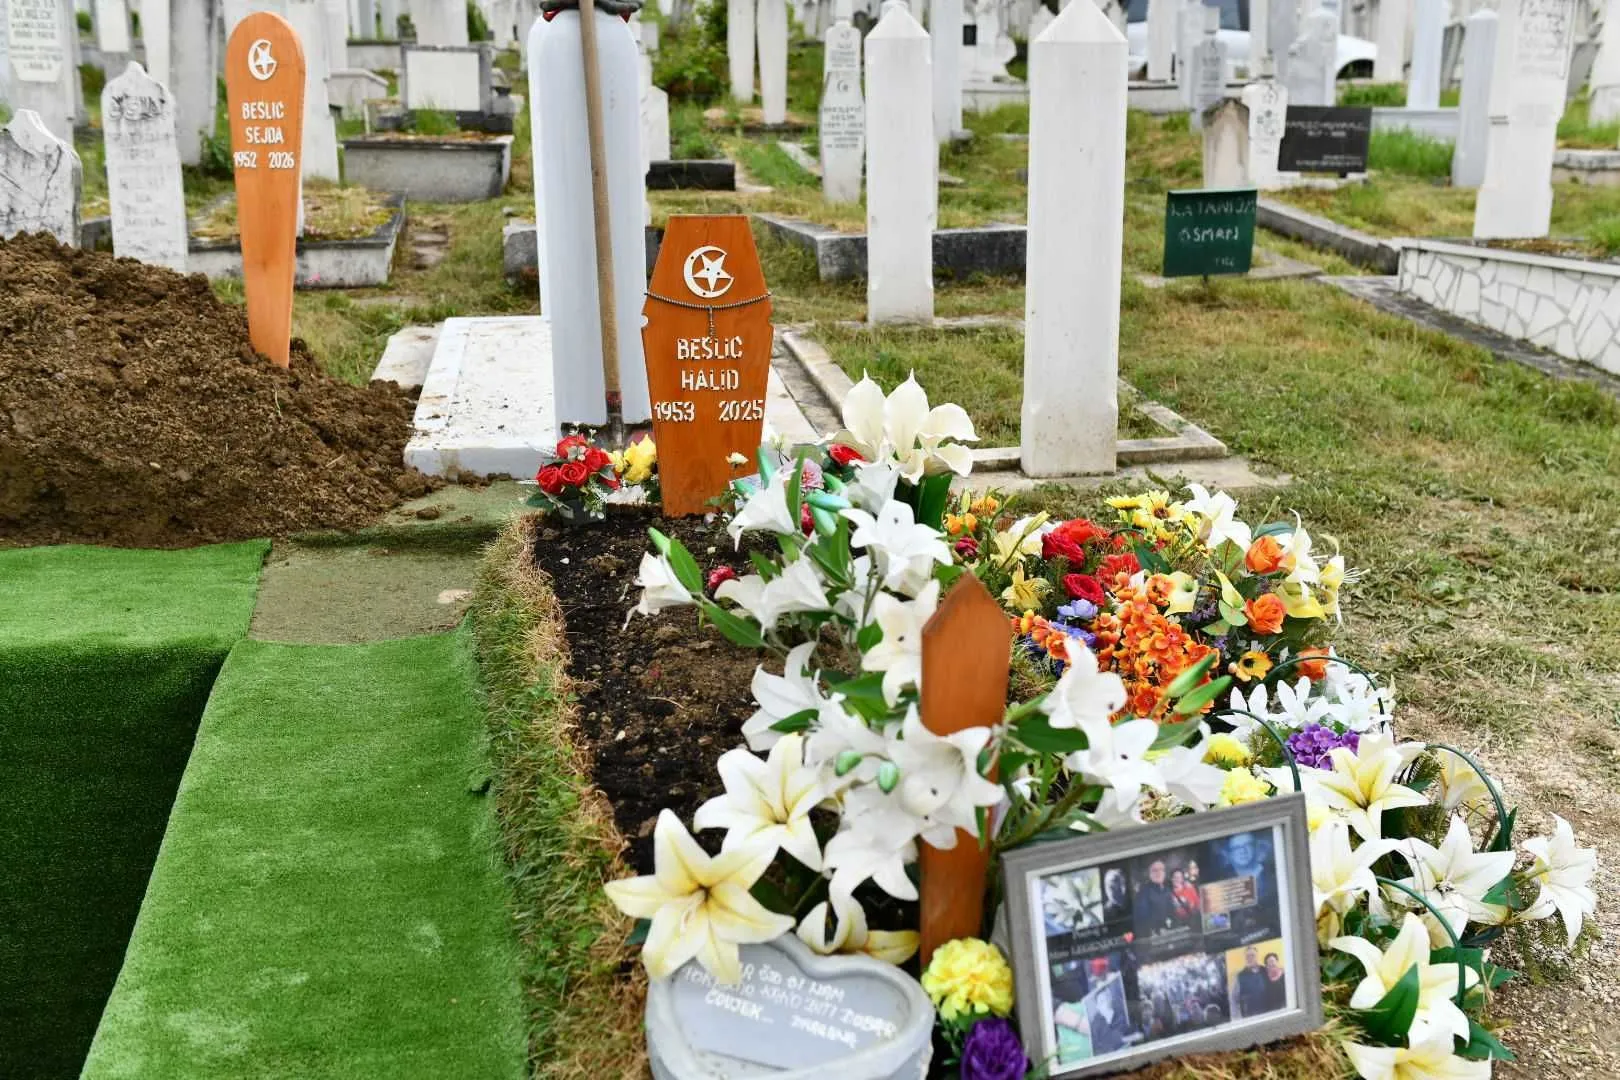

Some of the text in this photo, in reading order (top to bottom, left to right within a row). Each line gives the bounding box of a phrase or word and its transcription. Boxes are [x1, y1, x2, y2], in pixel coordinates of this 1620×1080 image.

[245, 126, 284, 144] SEJDA
[233, 151, 295, 168] 1952 2026
[680, 369, 740, 392] HALID
[654, 399, 764, 423] 1953 2025
